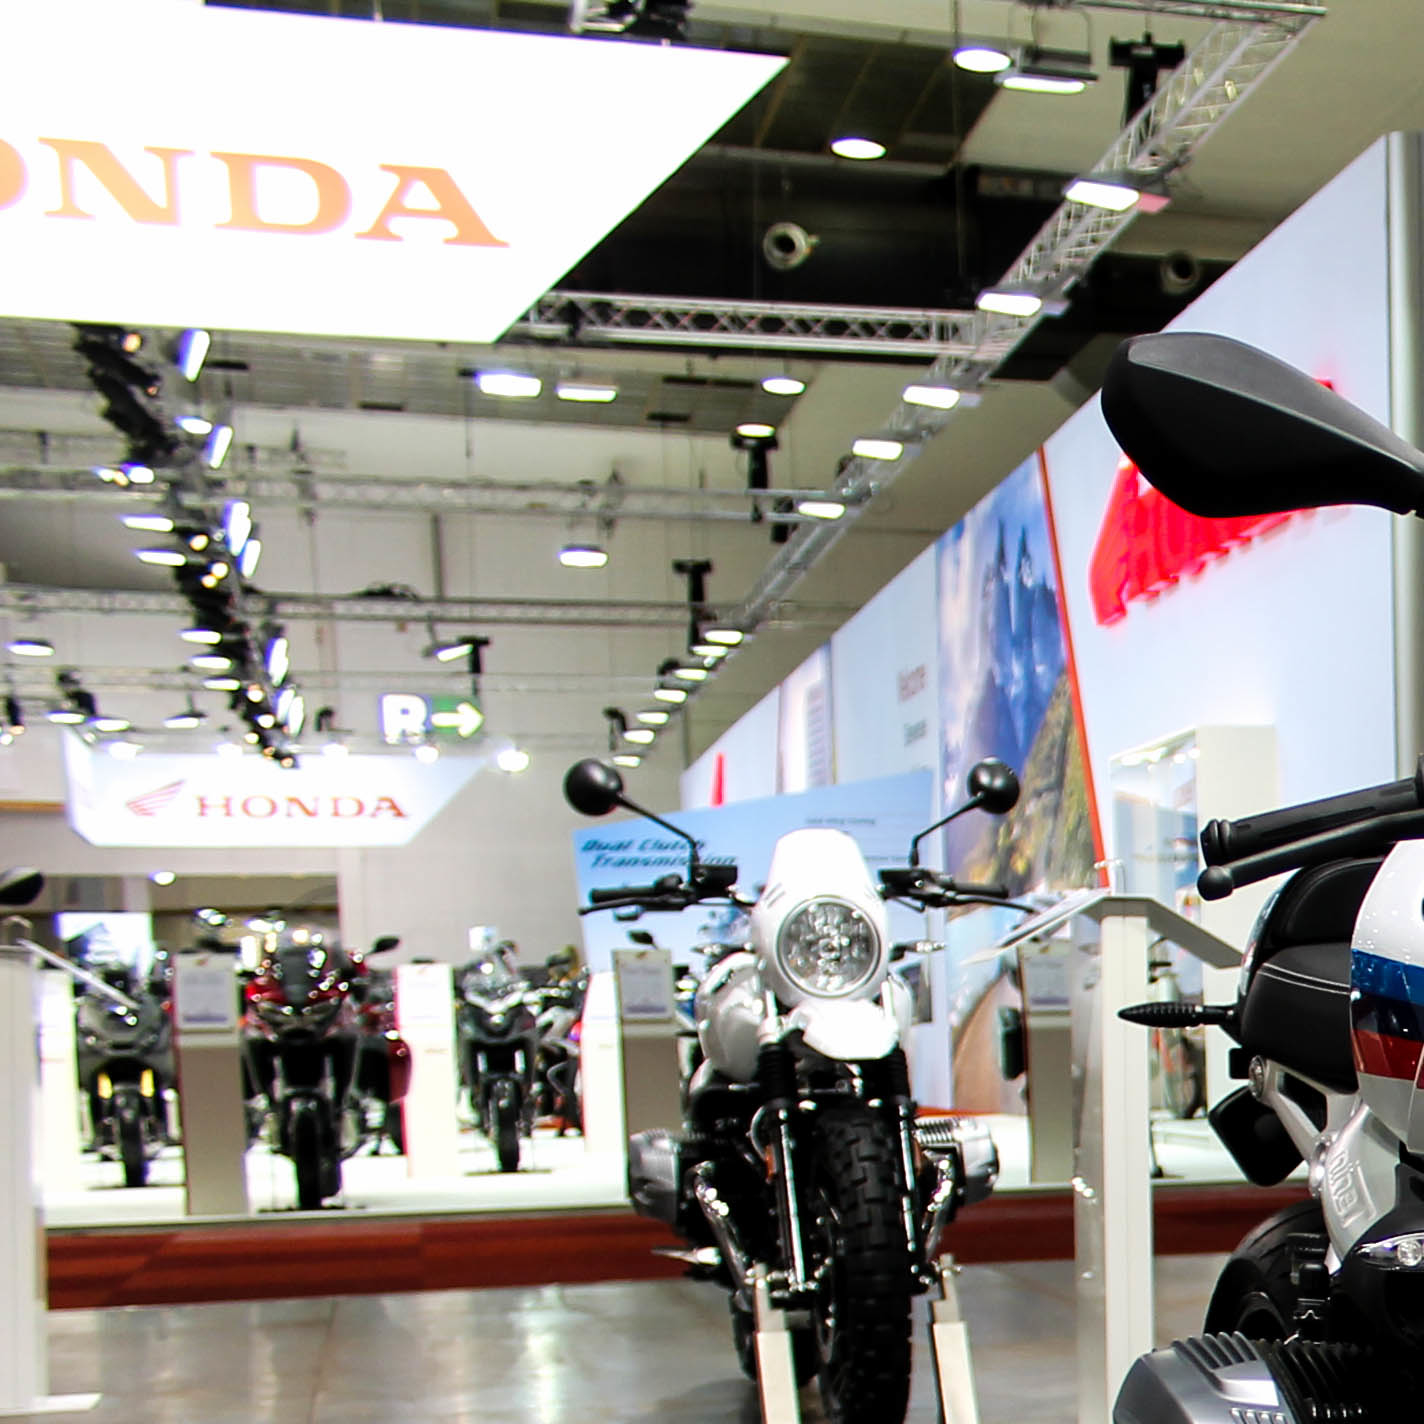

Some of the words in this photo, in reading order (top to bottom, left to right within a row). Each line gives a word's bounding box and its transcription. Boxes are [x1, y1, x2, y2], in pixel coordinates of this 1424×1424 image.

[0, 135, 511, 248] NDA
[195, 794, 408, 818] HONDA
[581, 838, 633, 852] Dual
